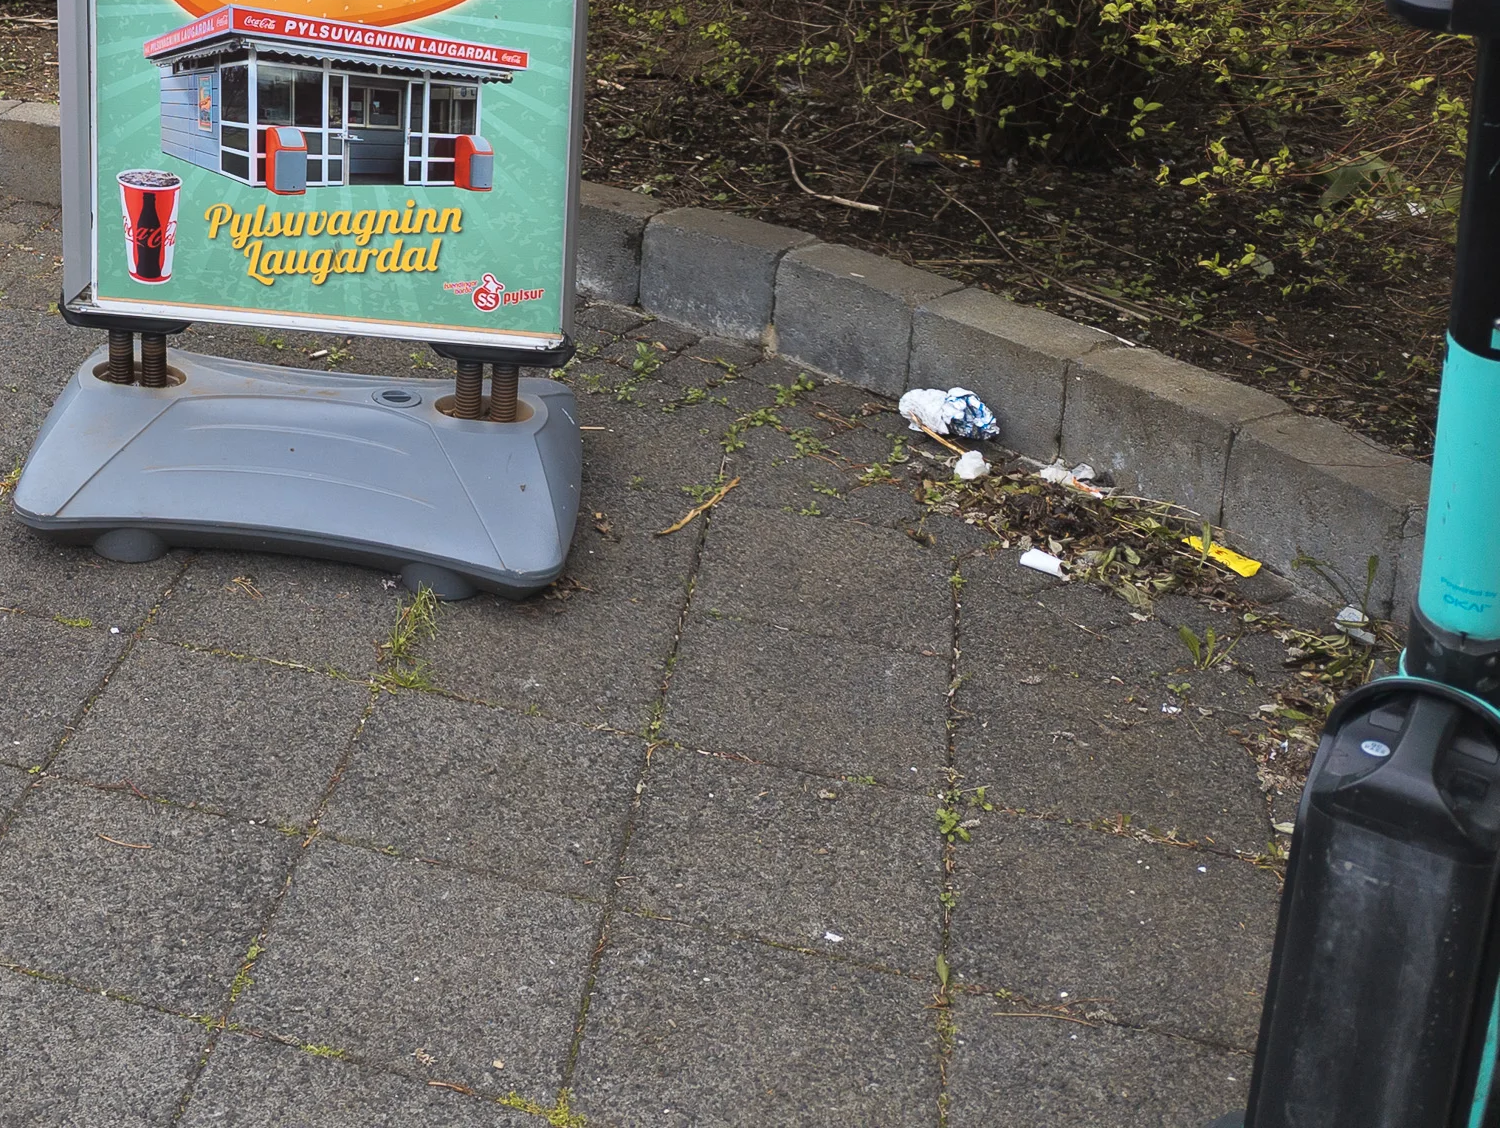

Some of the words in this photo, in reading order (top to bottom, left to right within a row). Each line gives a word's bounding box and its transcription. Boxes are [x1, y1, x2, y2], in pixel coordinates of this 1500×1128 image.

[181, 18, 215, 42] LAUGARDAL
[284, 19, 416, 51] PYLSUVAGNINN
[419, 39, 498, 62] LAUGARDAL
[204, 199, 462, 250] Pylsuvagninn
[243, 238, 441, 286] Laugardal
[477, 293, 496, 308] SS
[503, 288, 544, 305] pylsur
